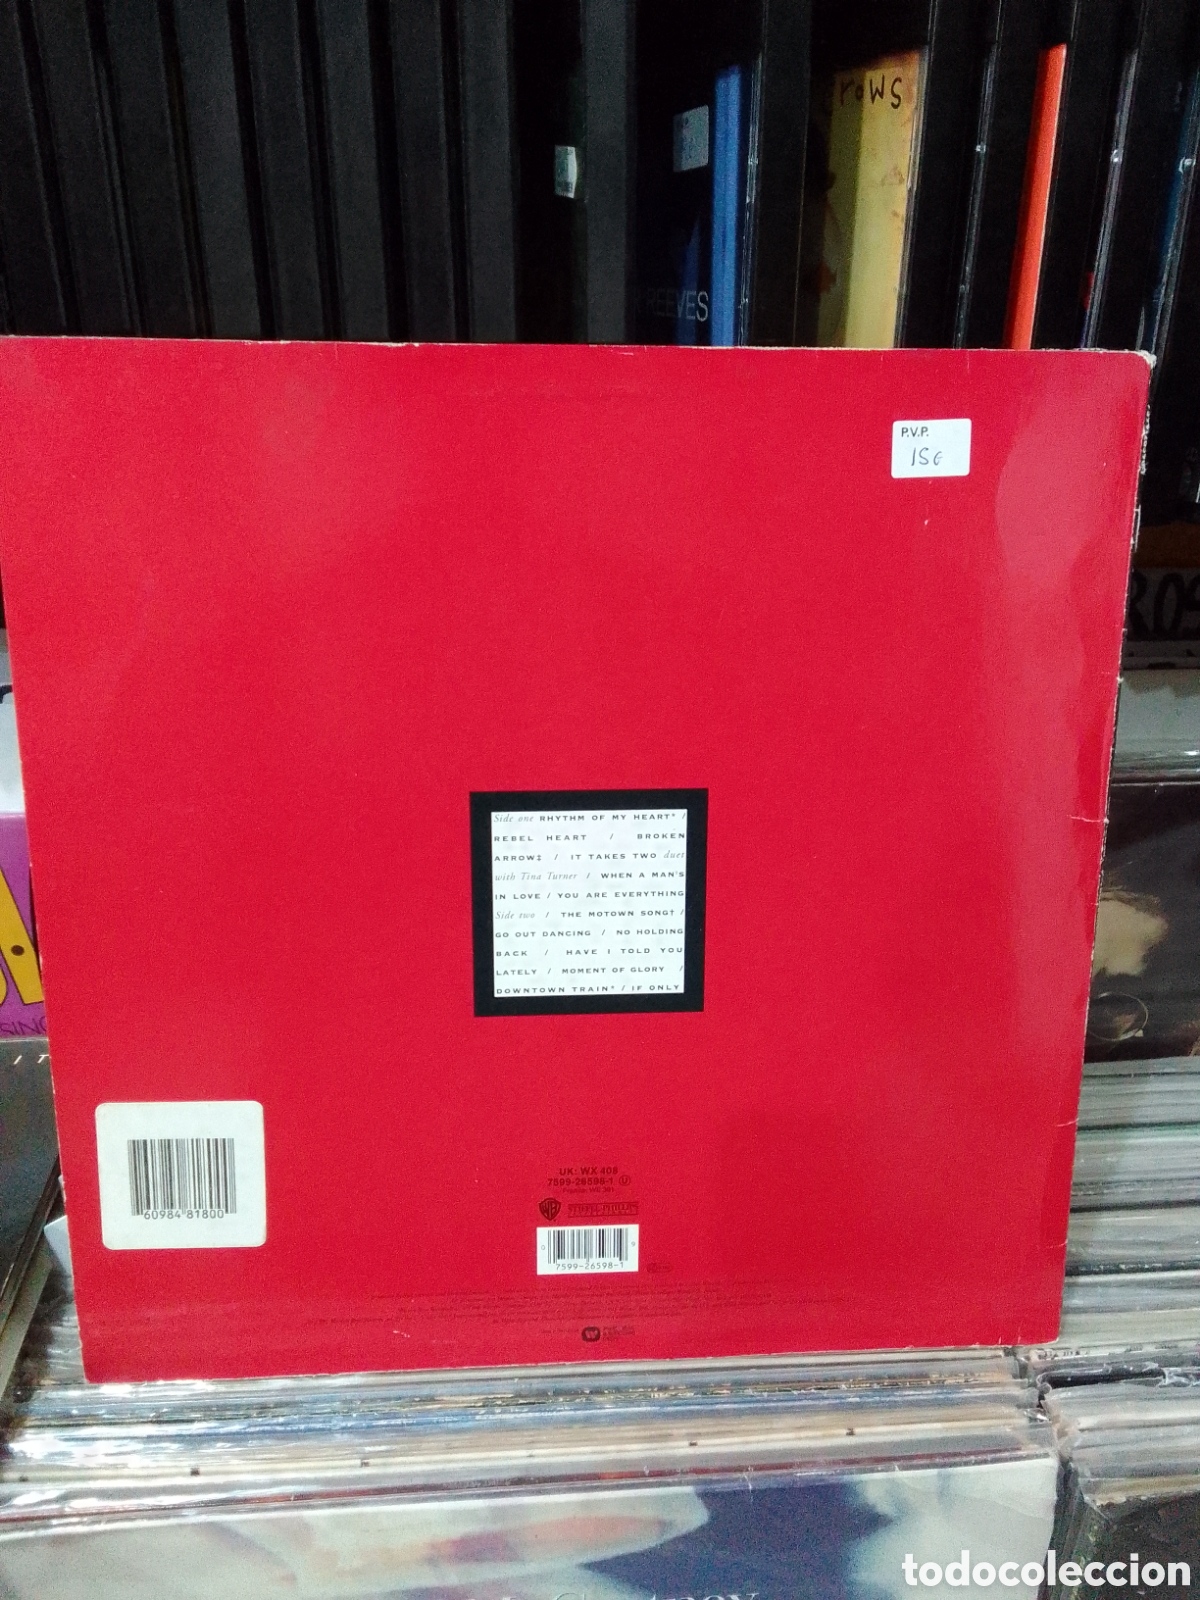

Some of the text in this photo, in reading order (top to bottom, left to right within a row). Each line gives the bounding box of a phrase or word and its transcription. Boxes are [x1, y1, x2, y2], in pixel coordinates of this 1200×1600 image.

[901, 426, 930, 438] P.V.P.
[494, 813, 514, 823] Side
[664, 849, 686, 859] duet
[494, 871, 516, 882] with
[520, 871, 542, 881] Tina
[546, 871, 578, 881] Turner
[494, 910, 514, 920] Side
[496, 986, 566, 995] DOWNTOWN
[580, 1166, 598, 1174] WX
[144, 1208, 224, 1220] 60984 81800
[556, 1261, 624, 1270] 7599-26598-1
